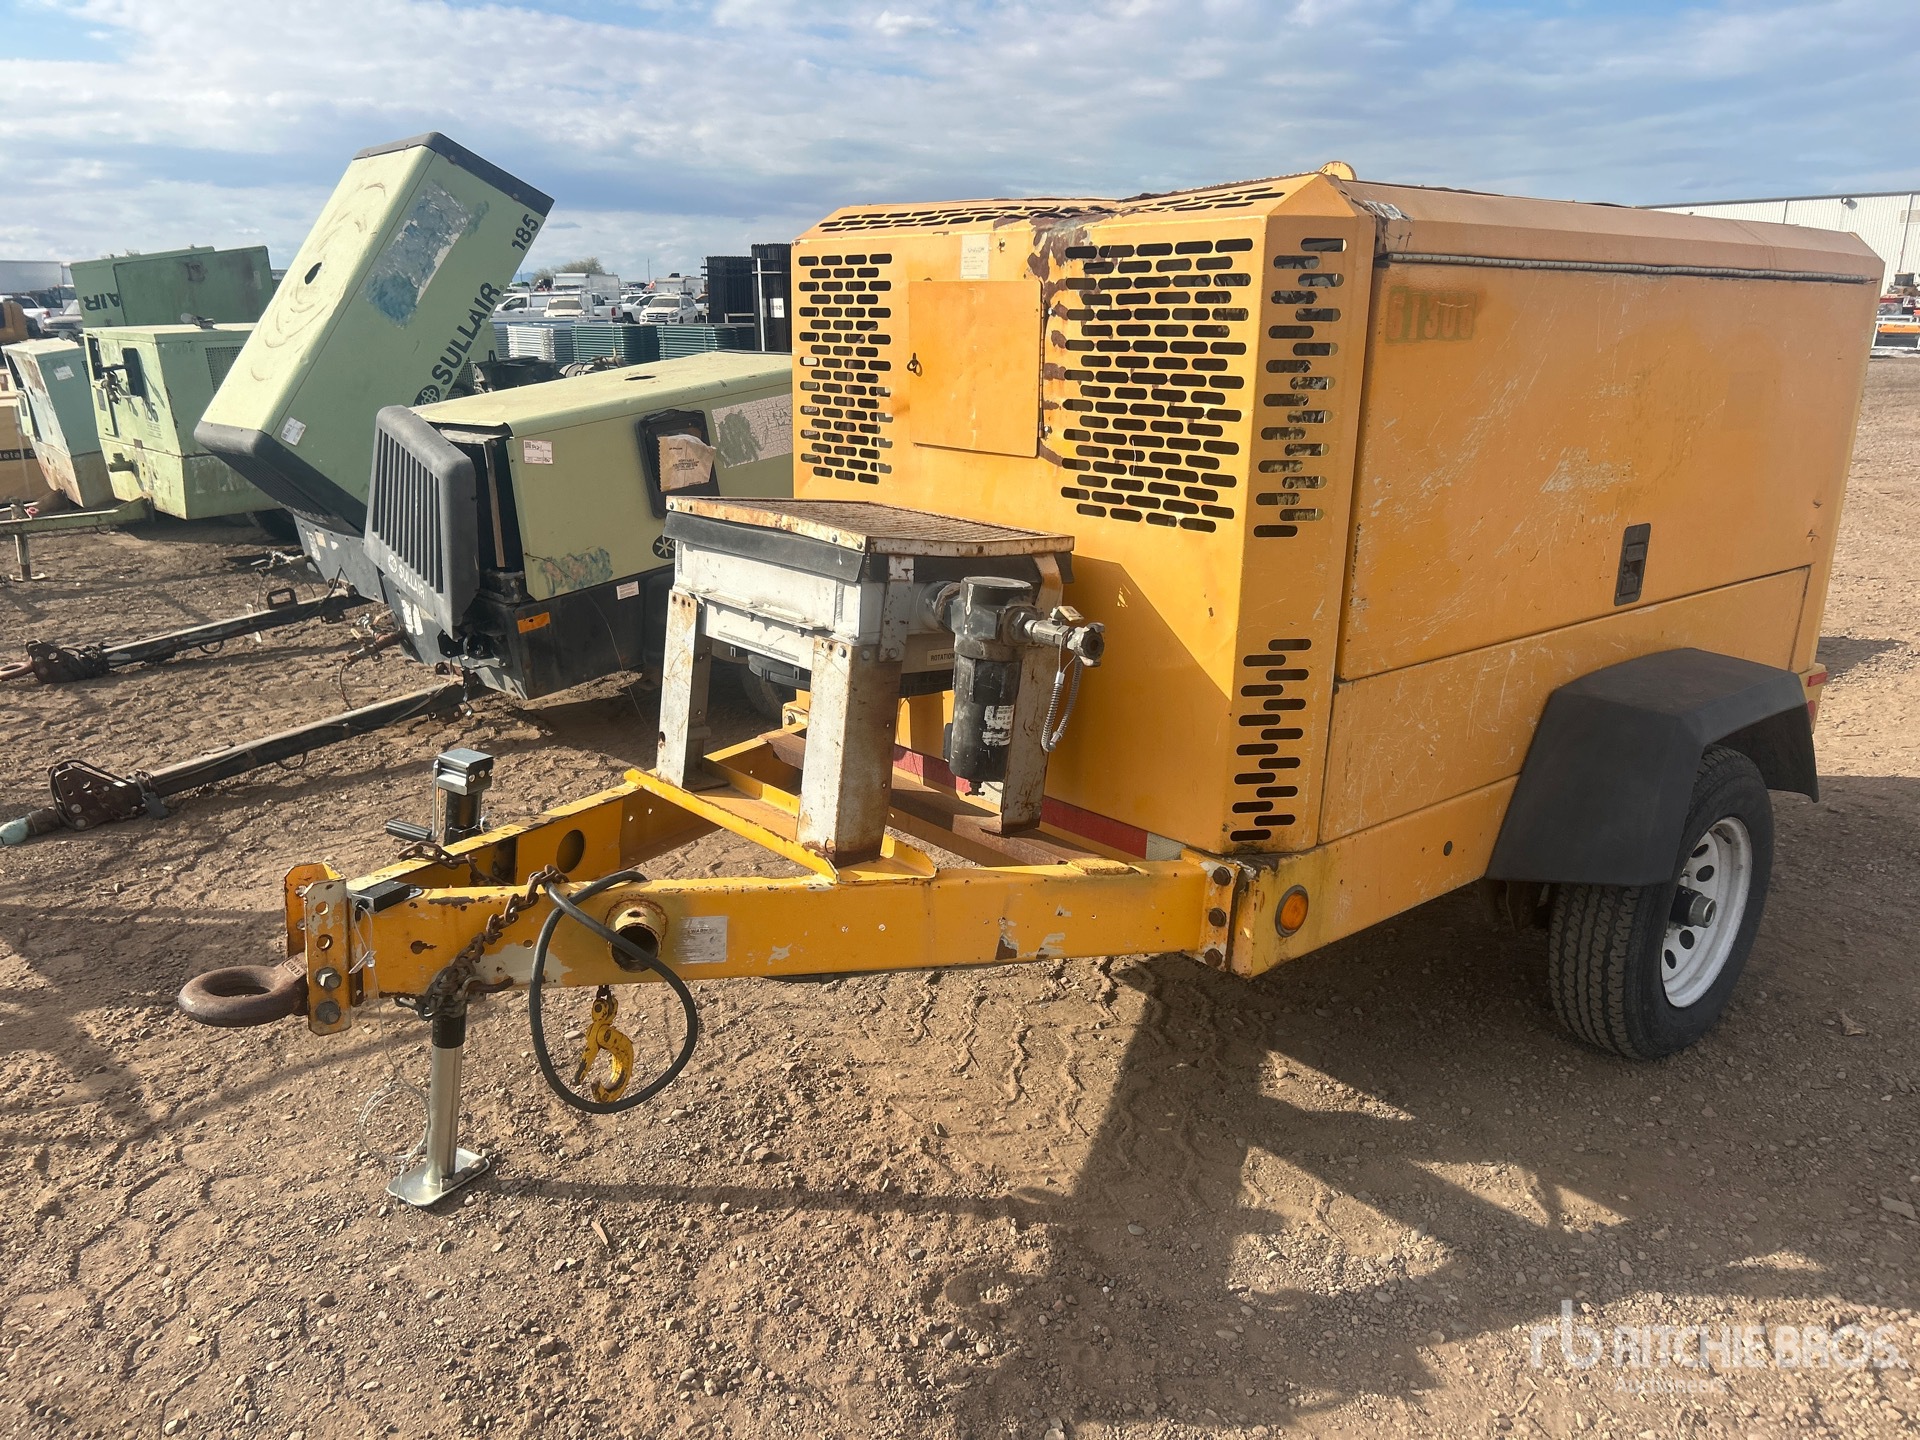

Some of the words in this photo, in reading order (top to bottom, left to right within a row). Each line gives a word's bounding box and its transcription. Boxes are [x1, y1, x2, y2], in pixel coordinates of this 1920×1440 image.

[511, 213, 539, 252] 185
[431, 282, 501, 386] SULLAIR
[398, 564, 425, 600] SULLAIR
